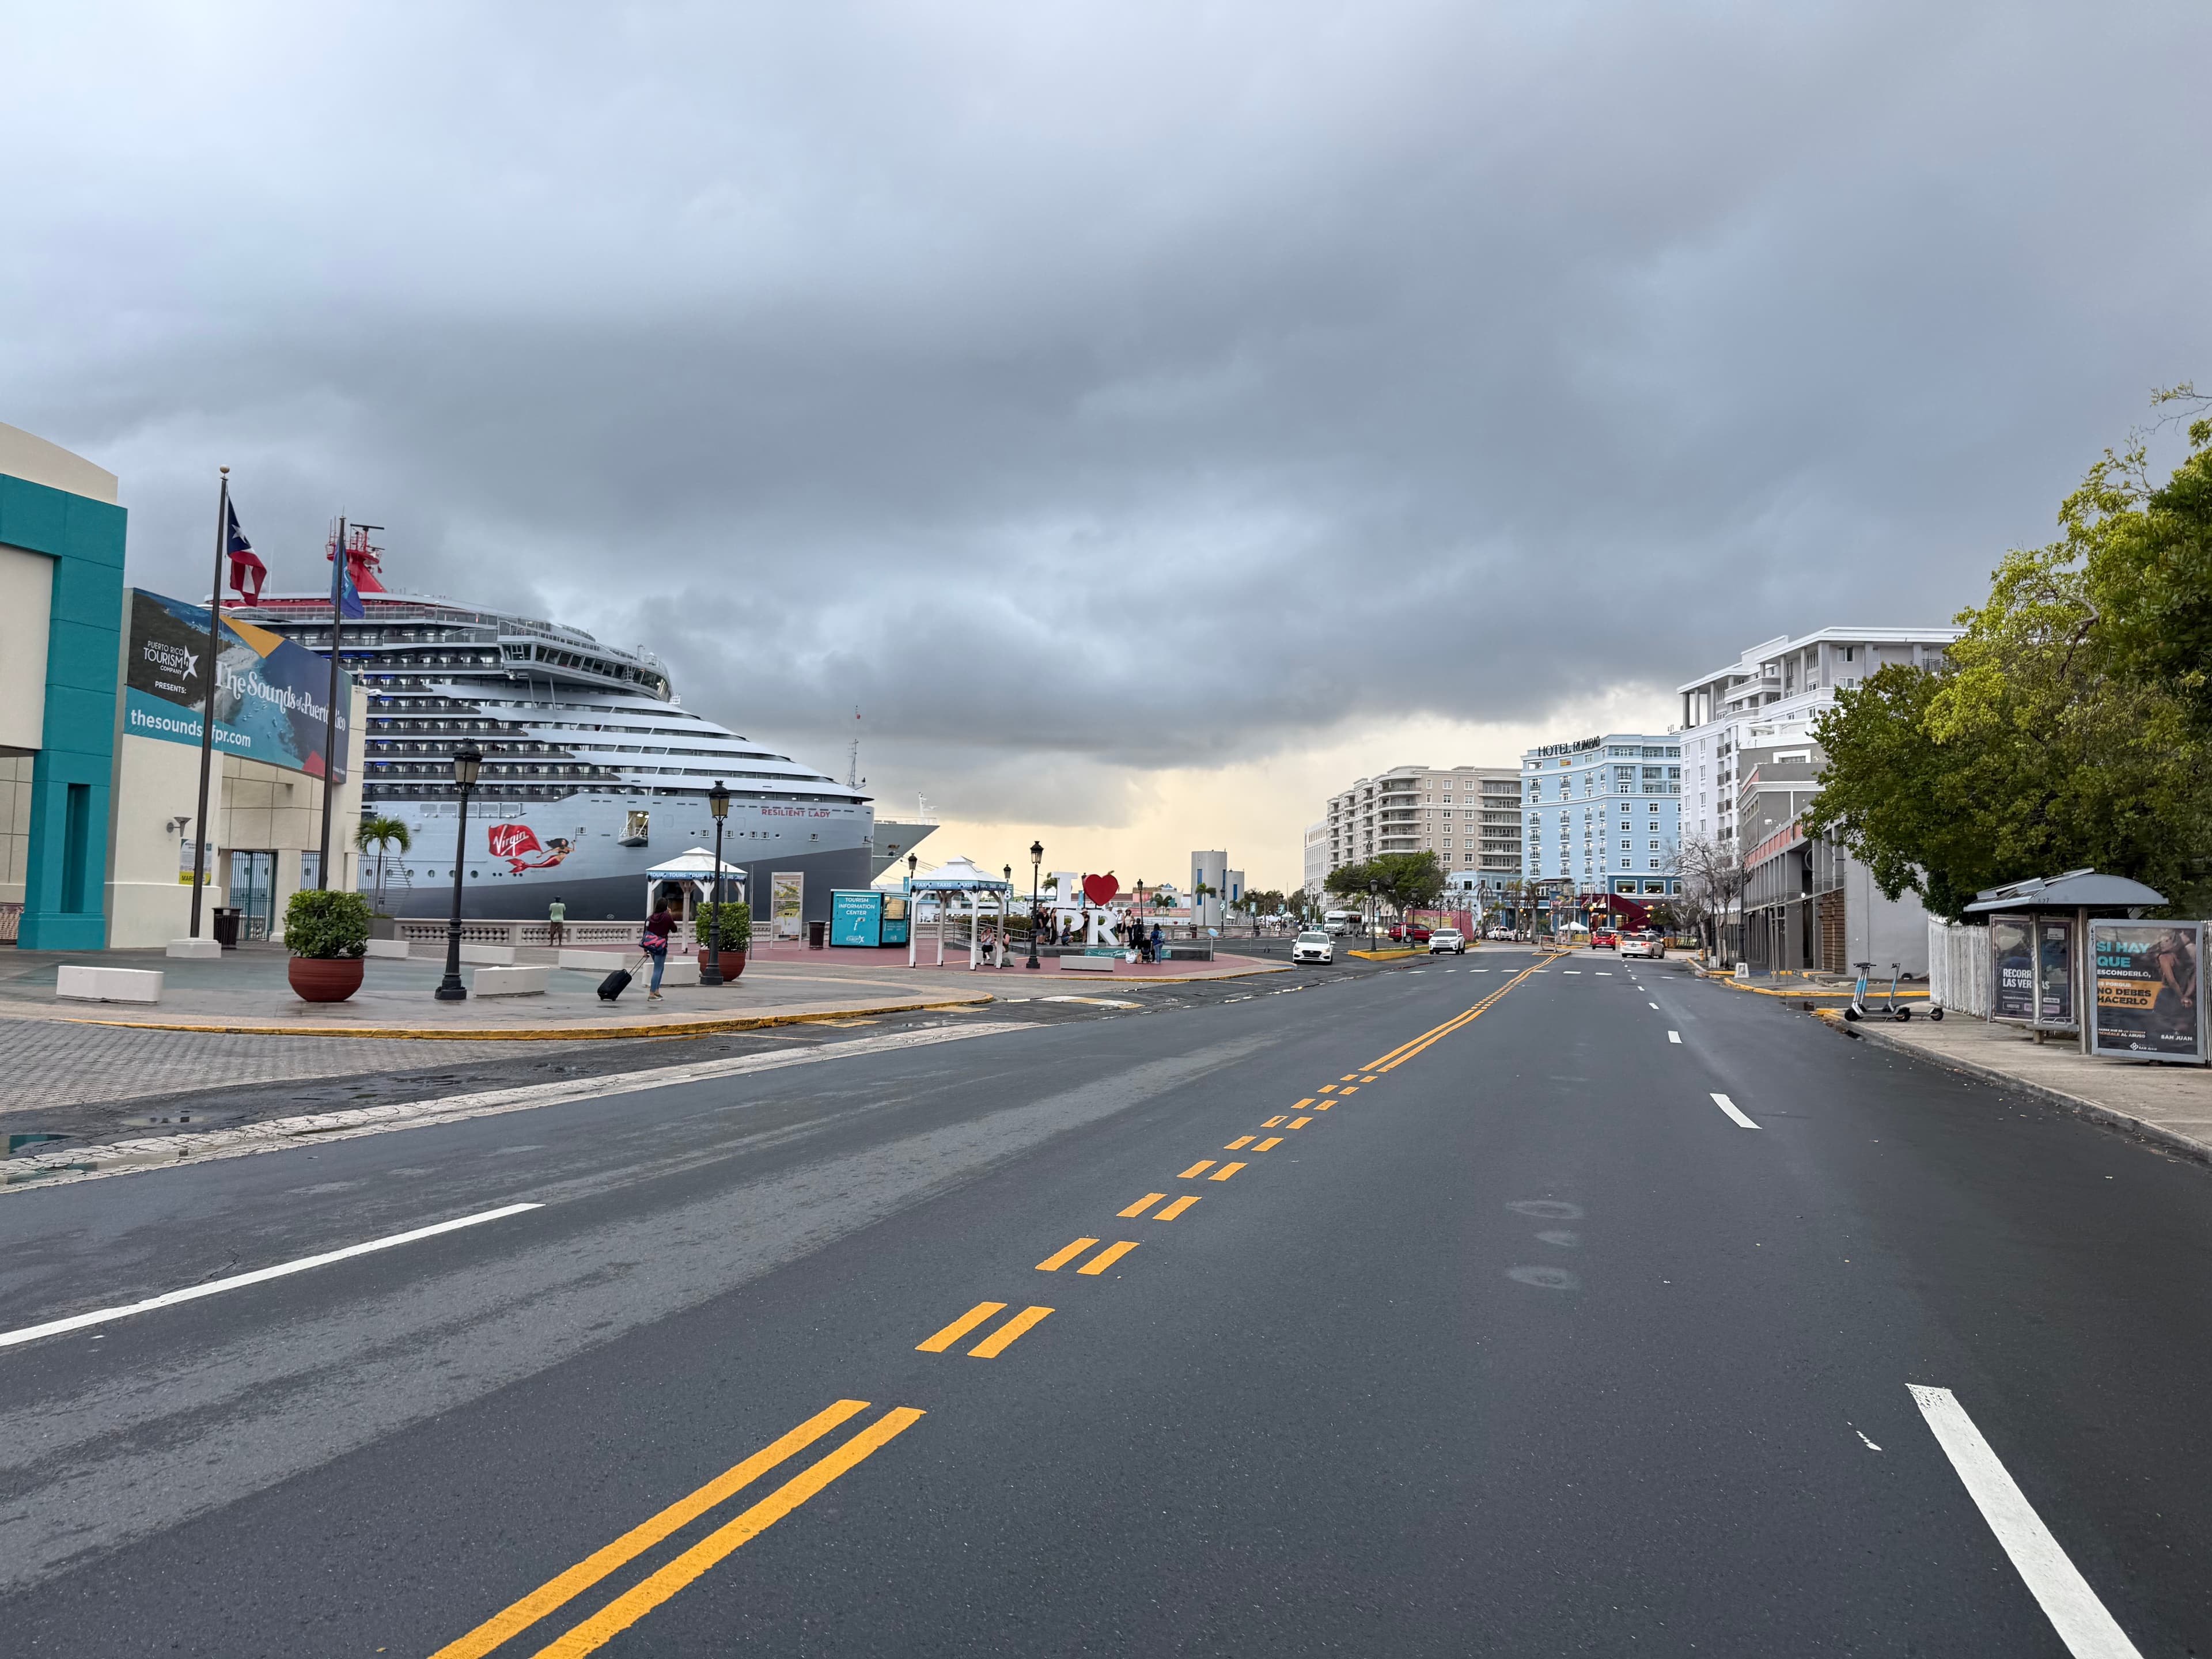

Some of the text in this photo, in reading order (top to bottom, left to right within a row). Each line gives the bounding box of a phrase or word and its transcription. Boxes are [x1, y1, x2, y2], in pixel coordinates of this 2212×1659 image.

[147, 641, 184, 656] PUERTO RICO
[143, 647, 183, 668] TOURISM
[160, 665, 182, 675] COMPANY
[155, 681, 187, 694] PRESENTS:
[247, 671, 296, 714] Sounds
[296, 697, 302, 710] of
[335, 707, 346, 732] ico
[131, 709, 251, 748] thesoundsfpr.com
[1538, 743, 1571, 757] HOTEL
[762, 809, 806, 817] RESILIENT
[493, 824, 529, 857] Virgin
[1050, 871, 1078, 908] I
[2096, 941, 2150, 953] SI HAY
[2097, 956, 2131, 968] QUE
[2097, 969, 2152, 978] ESCONDERLO,
[2003, 978, 2016, 987] LAS
[2116, 988, 2152, 997] DEBES
[2097, 996, 2148, 1005] HACERLO
